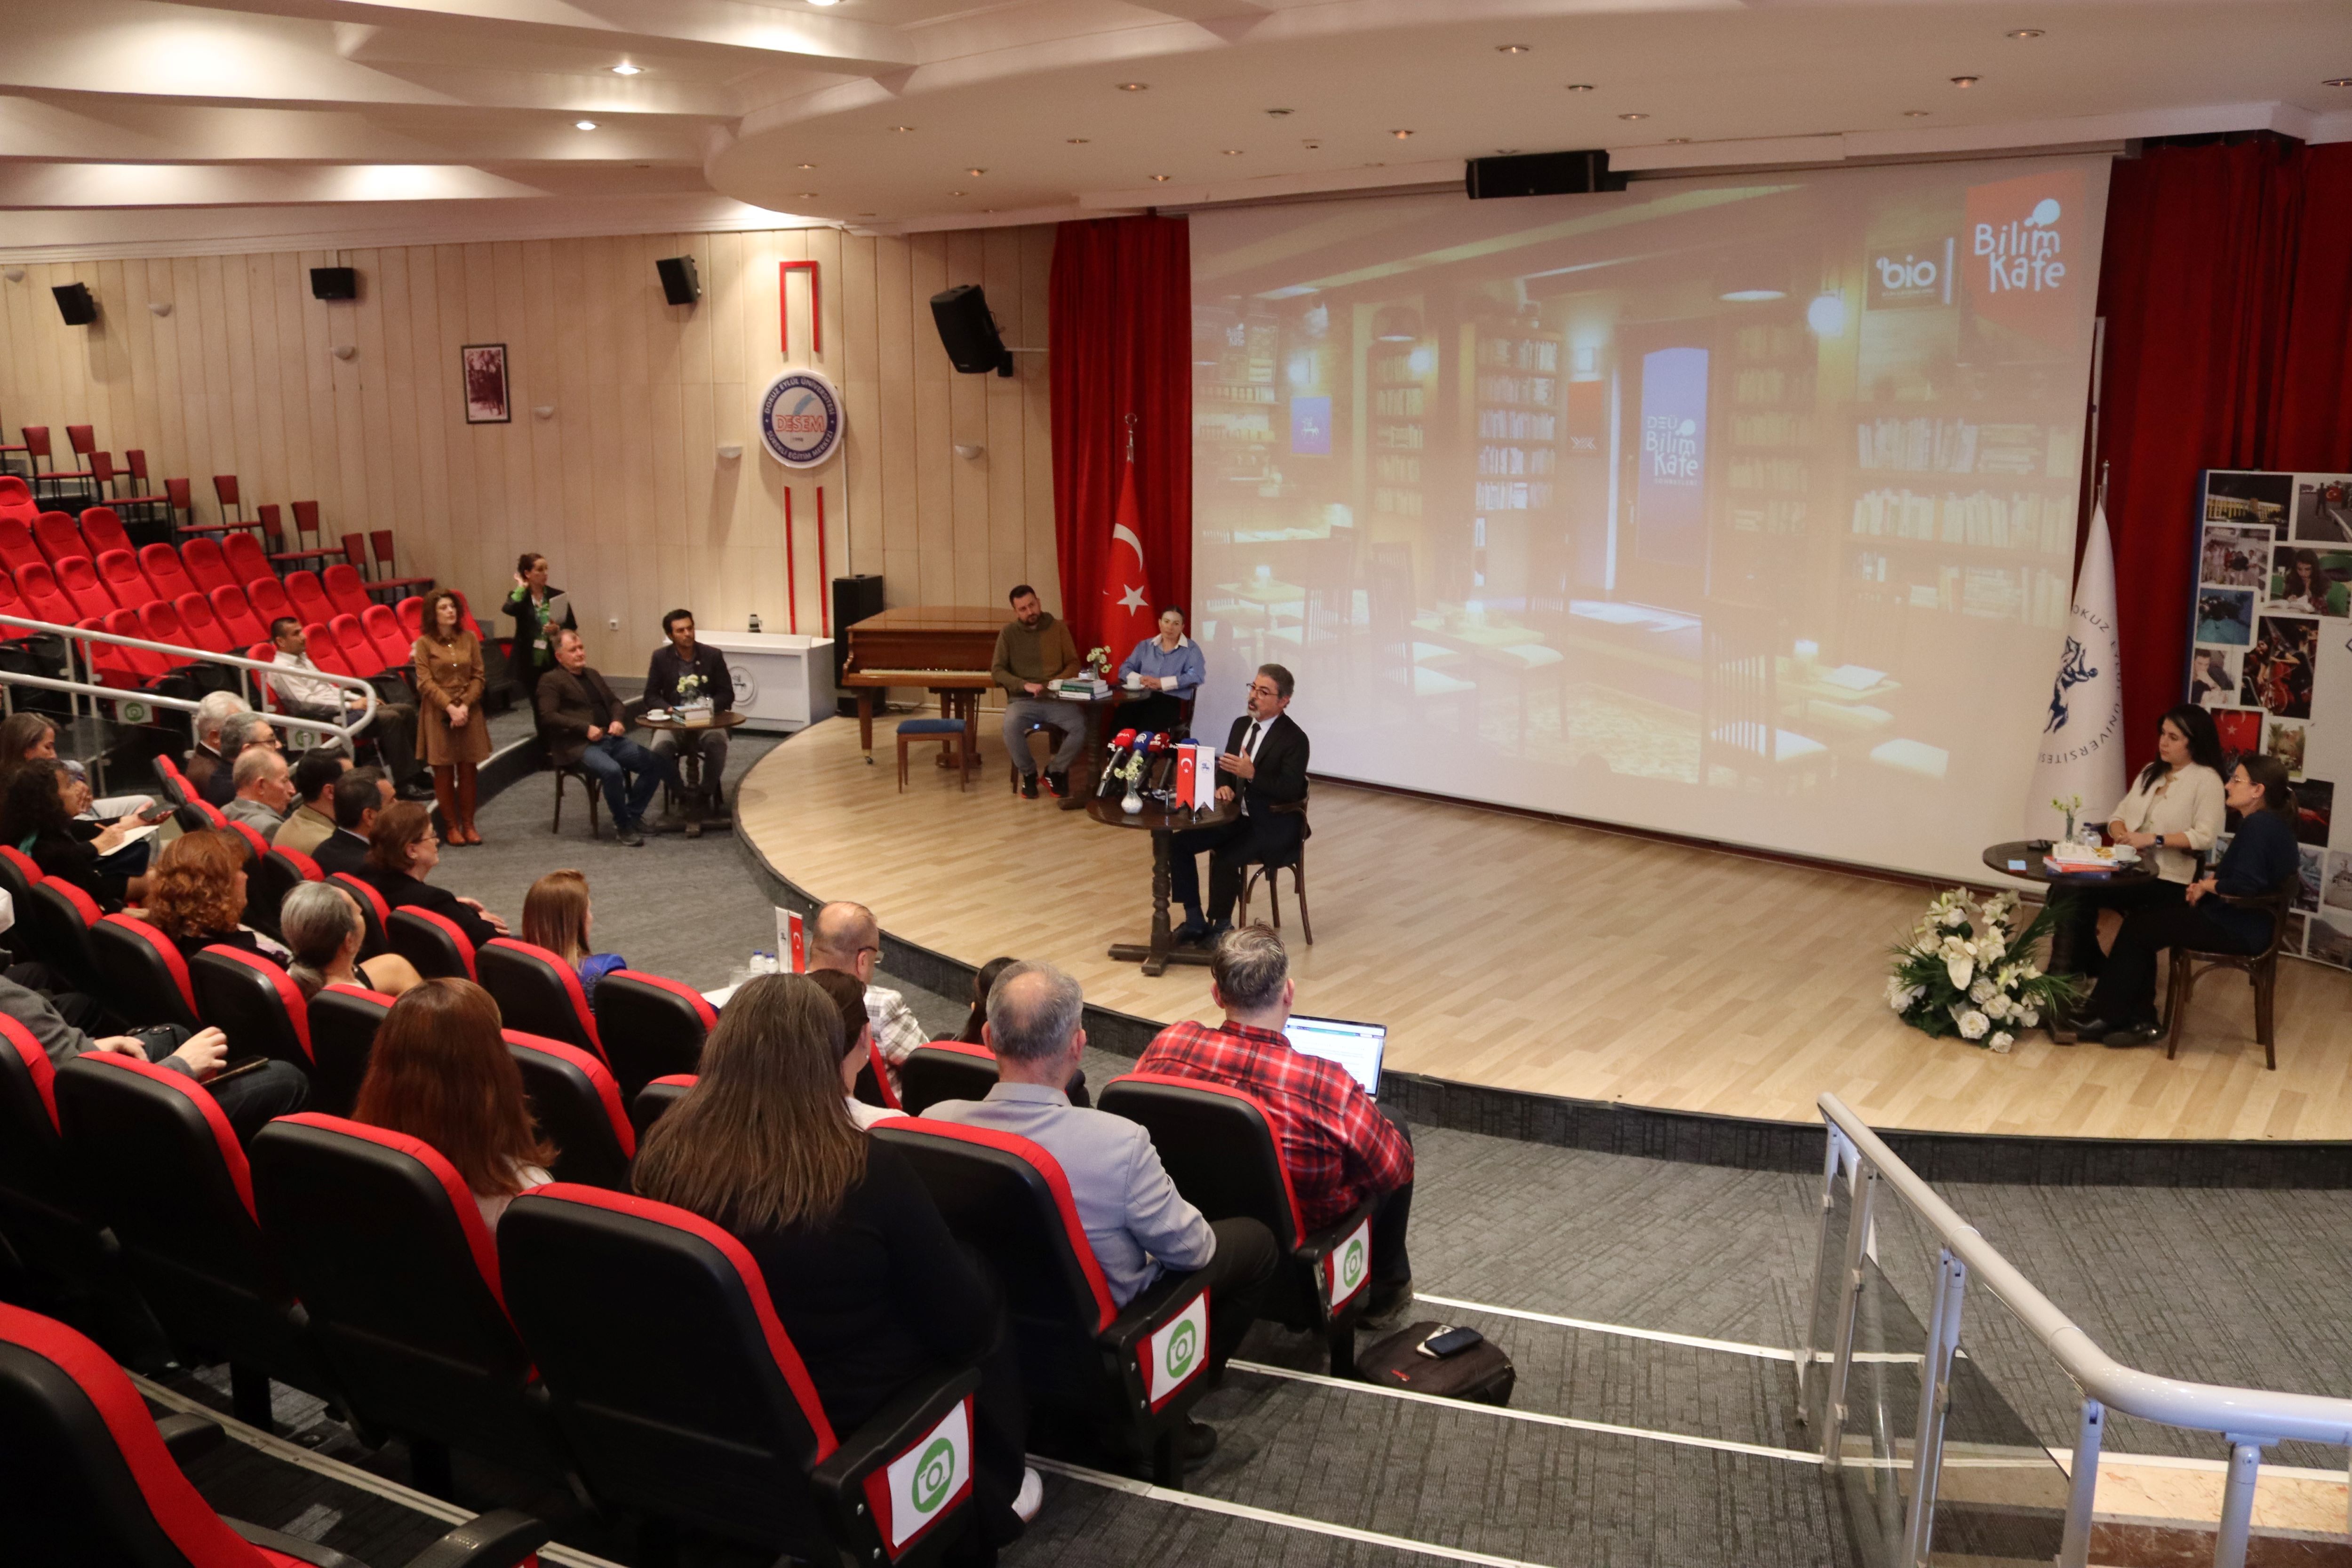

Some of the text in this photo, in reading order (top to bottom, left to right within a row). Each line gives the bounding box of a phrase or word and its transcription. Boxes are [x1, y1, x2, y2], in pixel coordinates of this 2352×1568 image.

[1974, 221, 2060, 257] Bilim
[1876, 255, 1937, 289] bio
[1989, 247, 2065, 293] Kafe
[765, 387, 779, 414] DOKUZ
[775, 414, 825, 432] DESEM
[1647, 414, 1678, 429] DEÜ
[1646, 430, 1696, 454] Bilim
[1654, 449, 1698, 478] Kafe
[2073, 605, 2110, 632] OKUZ
